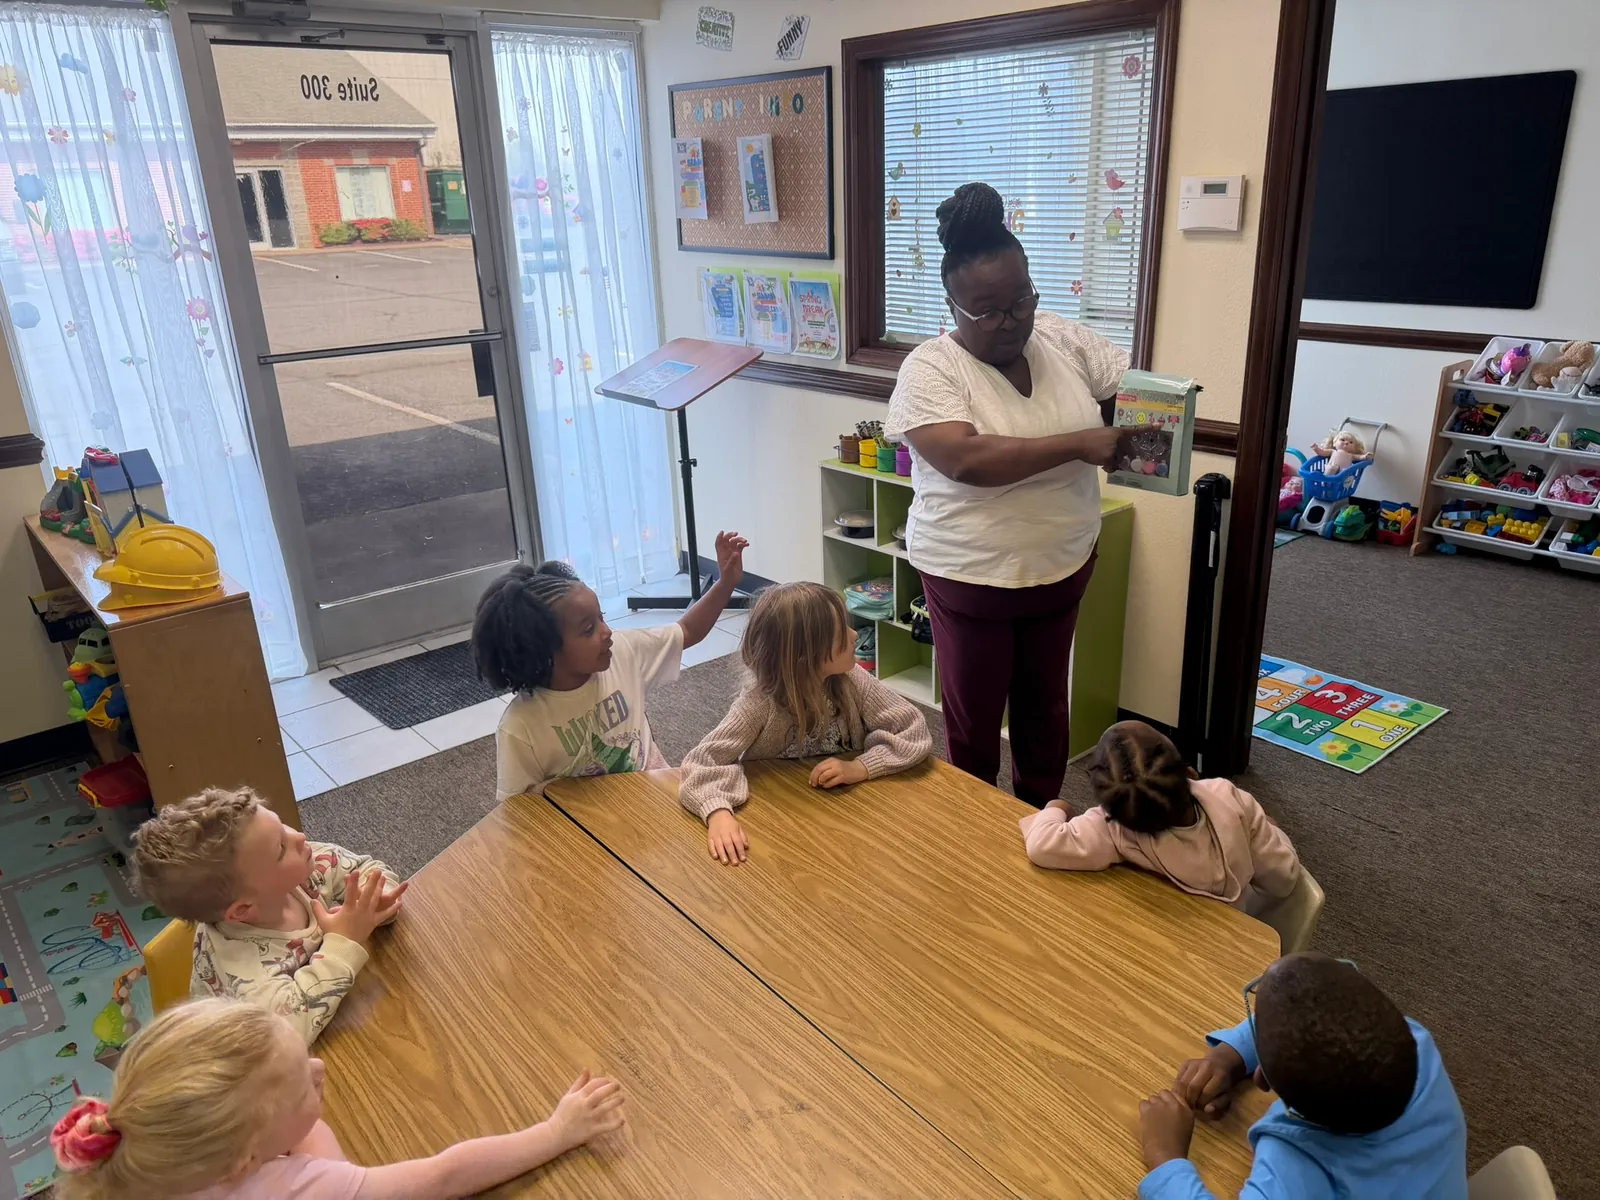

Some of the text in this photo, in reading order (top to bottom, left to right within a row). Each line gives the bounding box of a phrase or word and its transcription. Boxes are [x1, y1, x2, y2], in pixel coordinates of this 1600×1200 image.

[777, 20, 803, 56] FUNNY
[1256, 686, 1283, 701] 4
[1272, 688, 1307, 708] FOUR
[1314, 689, 1347, 704] 3
[1336, 693, 1375, 716] THREE
[1276, 712, 1312, 729] 2
[1302, 719, 1332, 736] TWO
[1351, 719, 1386, 732] 1
[1379, 725, 1408, 743] ONE
